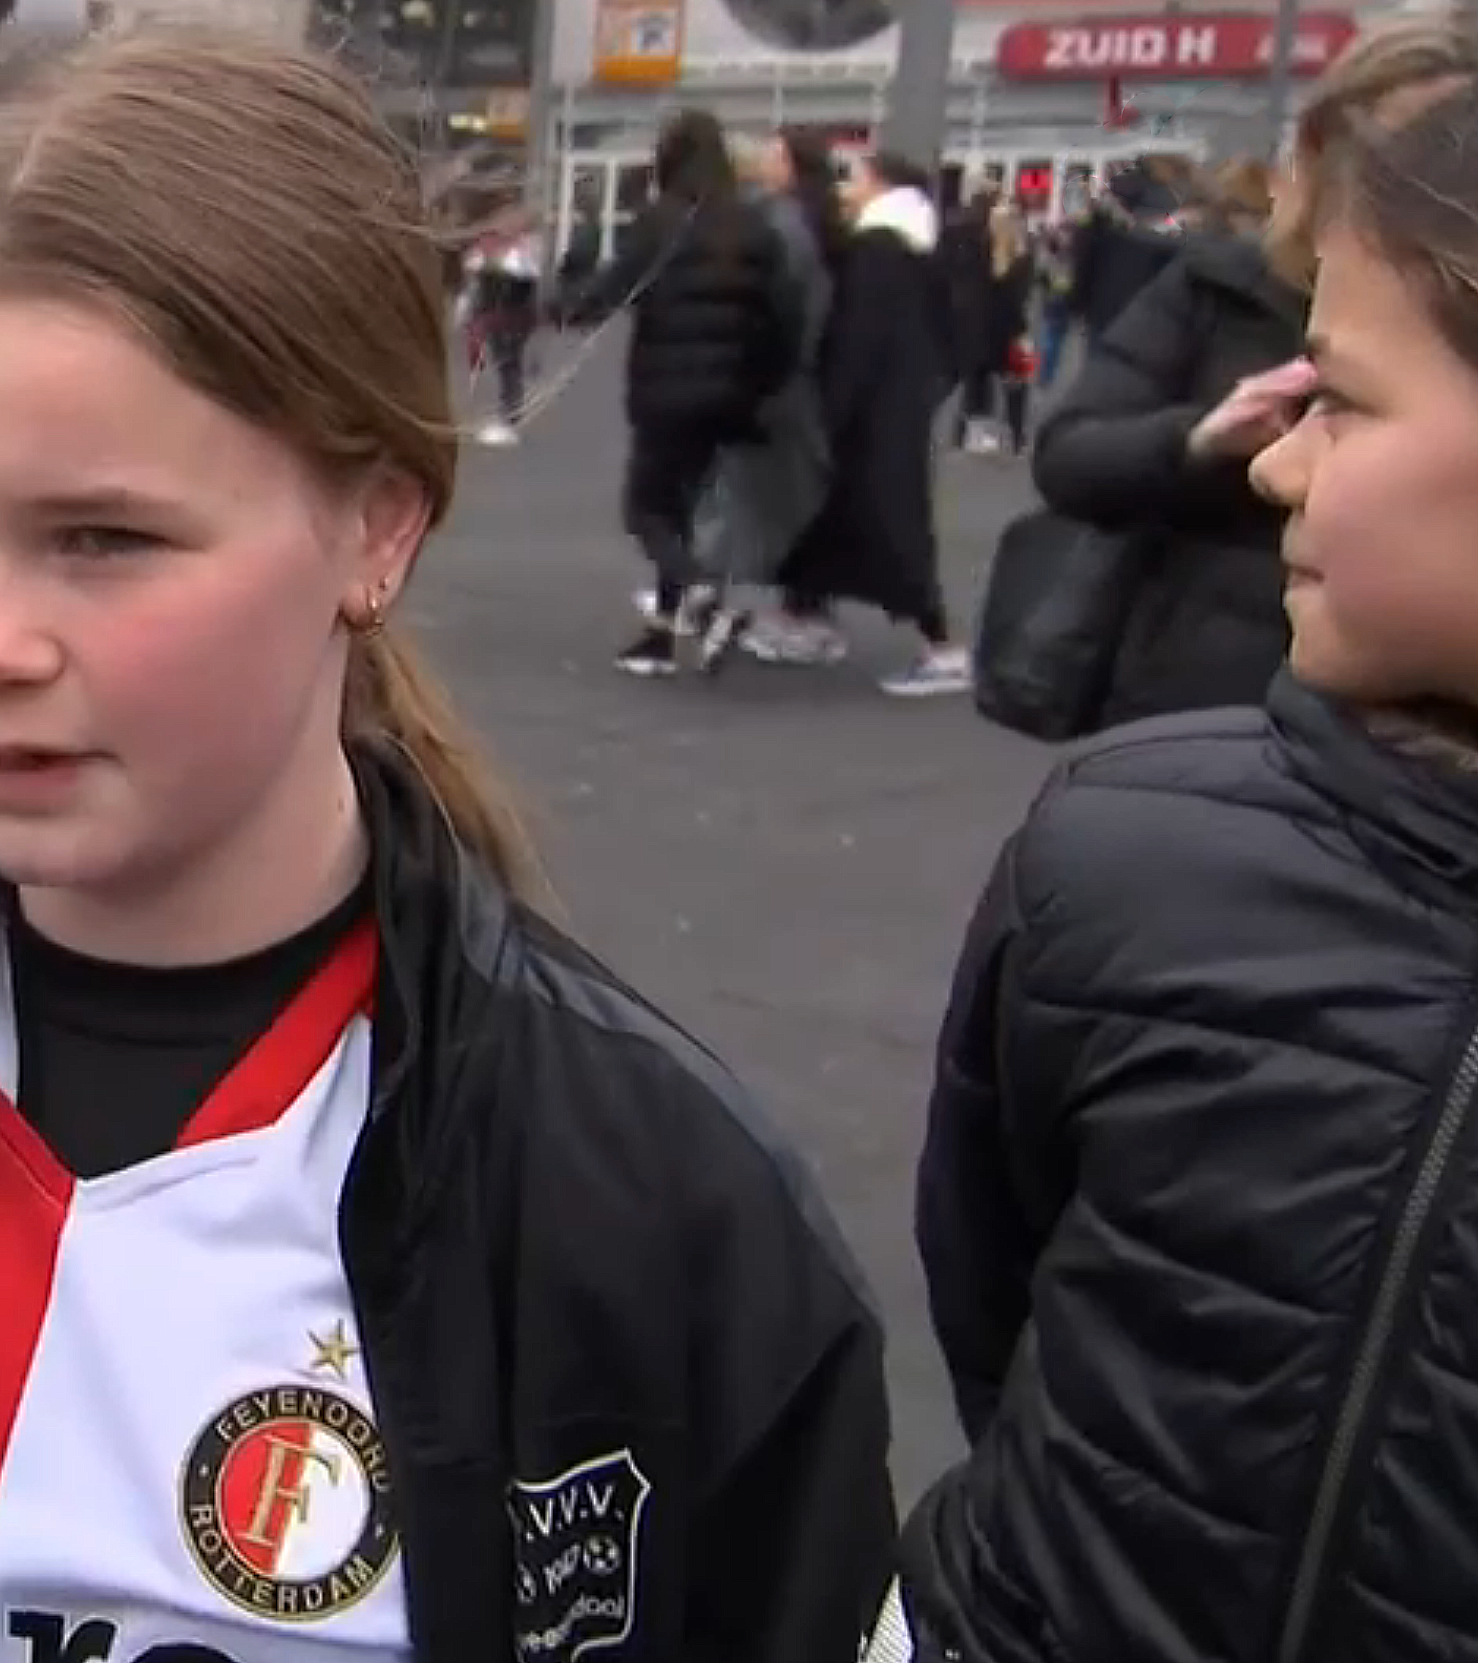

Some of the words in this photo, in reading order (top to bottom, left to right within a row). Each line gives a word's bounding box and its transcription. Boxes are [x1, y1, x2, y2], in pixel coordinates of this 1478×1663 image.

[1043, 26, 1165, 69] ZUID
[1176, 26, 1217, 64] H
[216, 1388, 391, 1493] FEYENOORD
[190, 1503, 374, 1613] ROTTERDAM
